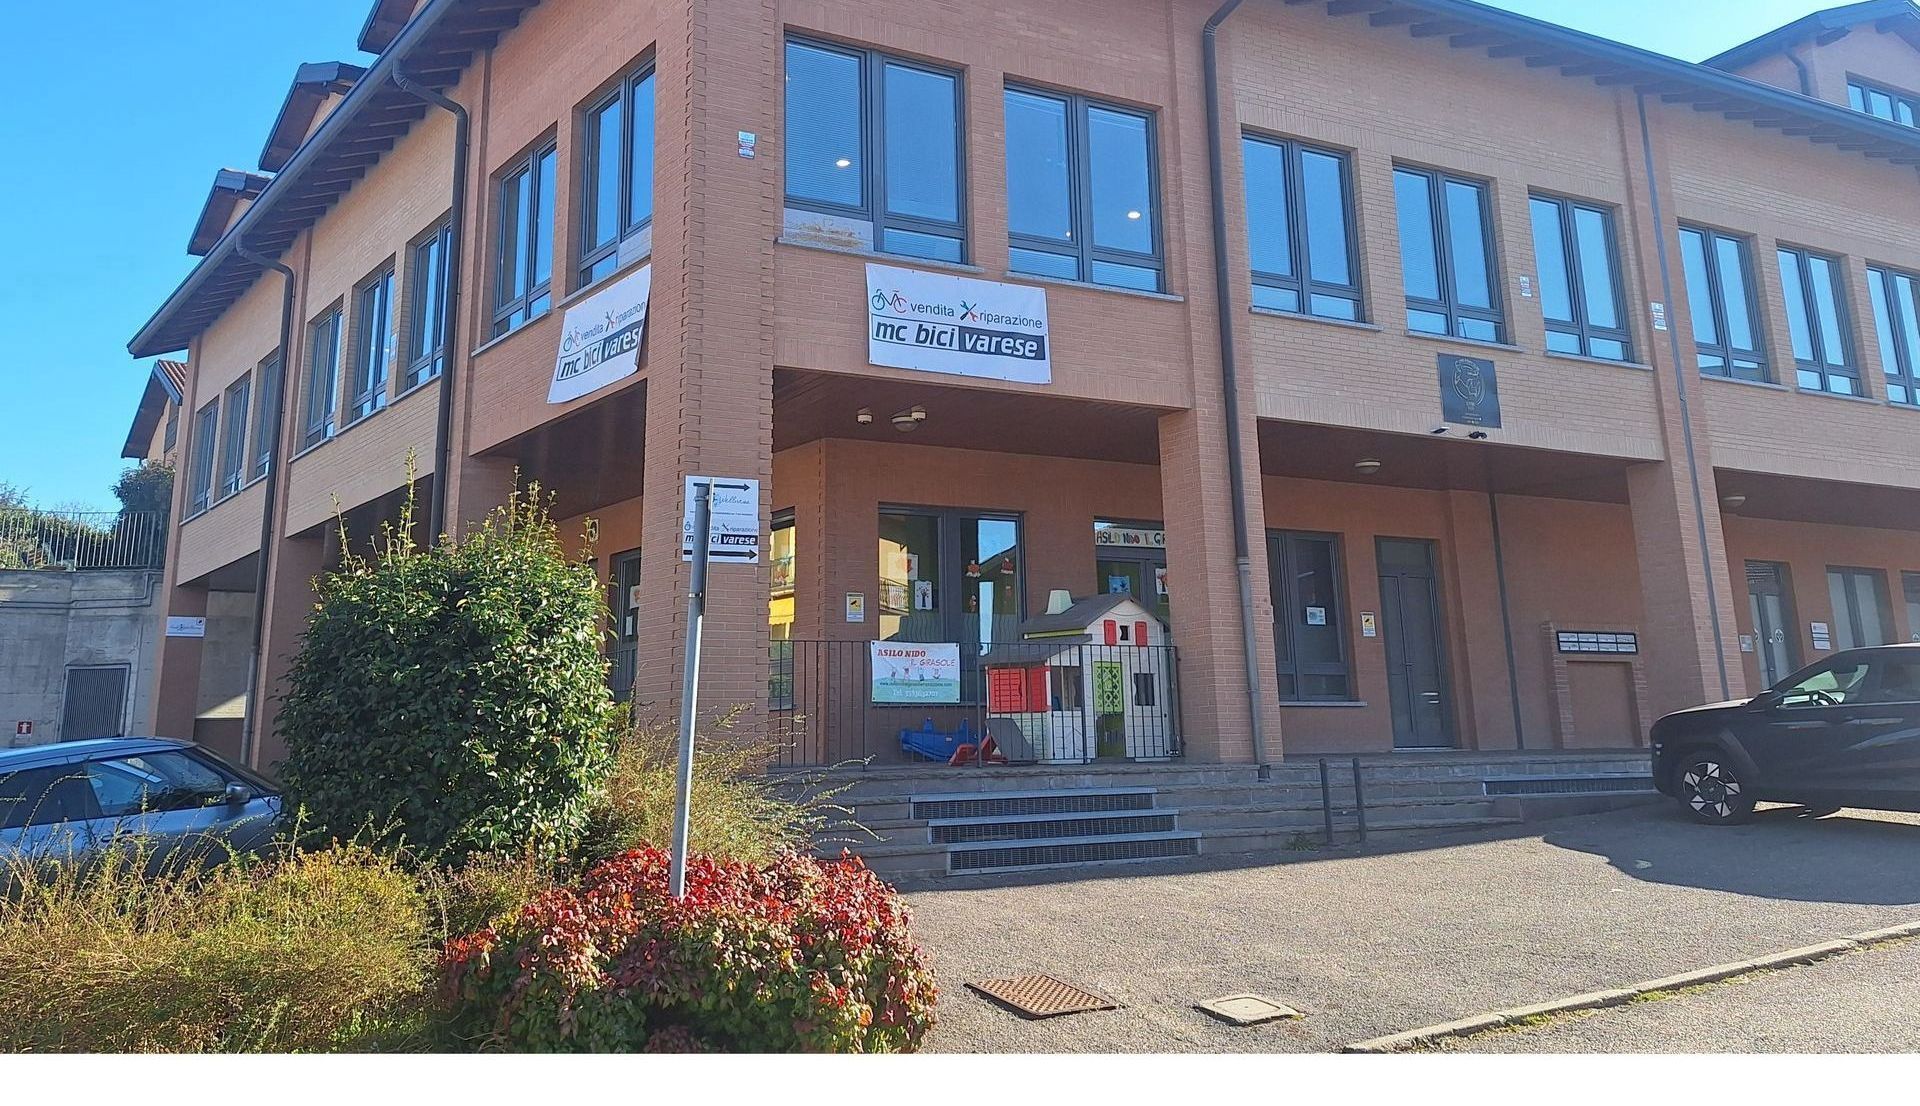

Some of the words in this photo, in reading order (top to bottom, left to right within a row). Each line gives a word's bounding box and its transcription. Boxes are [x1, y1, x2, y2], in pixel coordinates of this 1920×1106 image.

[910, 302, 955, 317] vendita
[979, 310, 1043, 329] riparazione
[581, 324, 604, 340] vendita
[875, 321, 908, 342] mc
[915, 323, 956, 348] bici
[965, 332, 1038, 358] varese
[560, 357, 582, 378] mc
[583, 341, 602, 370] bici
[604, 325, 642, 359] vares
[723, 535, 756, 545] varese
[877, 649, 904, 657] ASILO
[905, 650, 926, 658] NIDO
